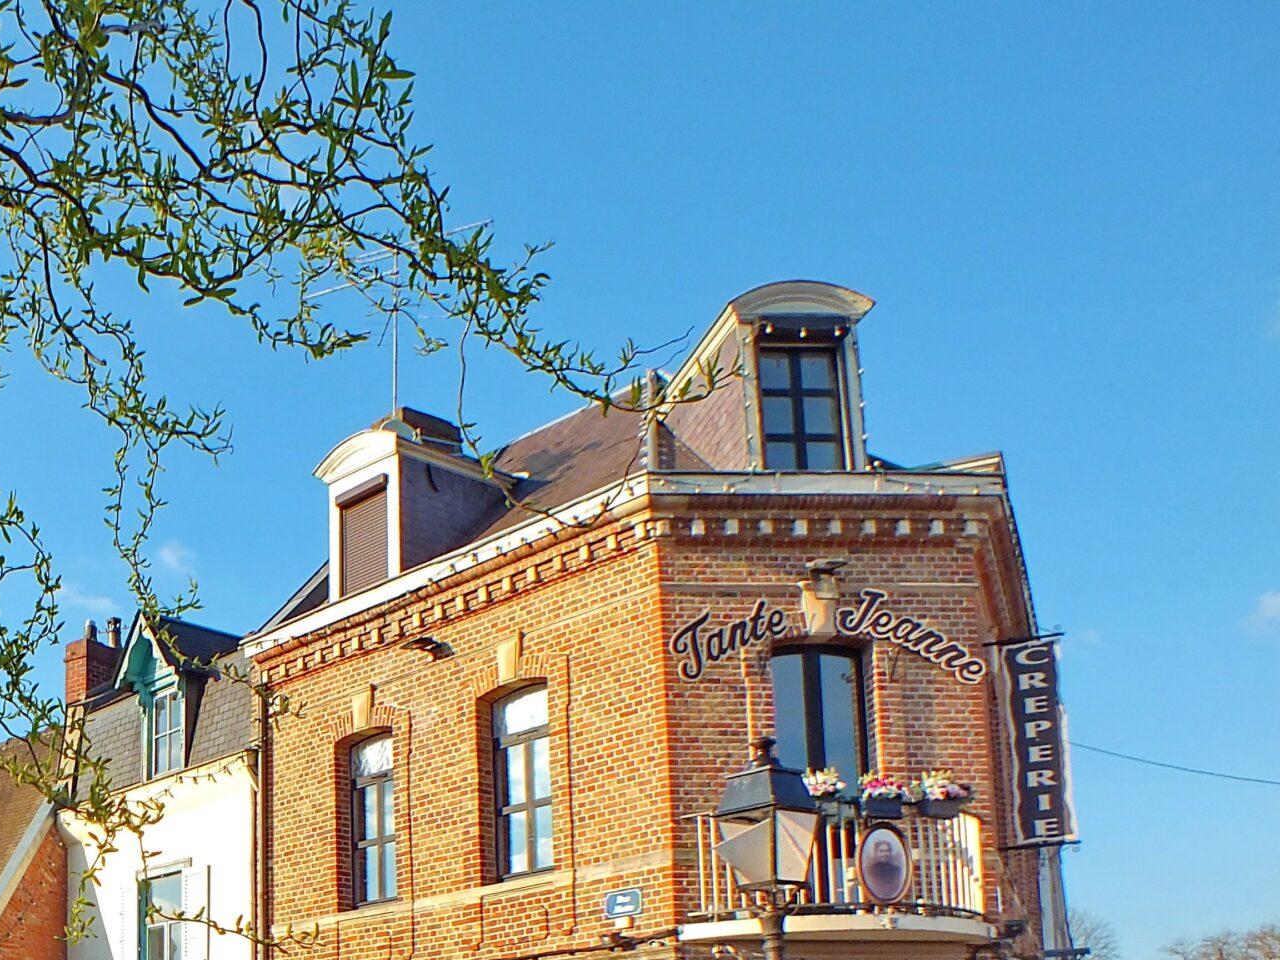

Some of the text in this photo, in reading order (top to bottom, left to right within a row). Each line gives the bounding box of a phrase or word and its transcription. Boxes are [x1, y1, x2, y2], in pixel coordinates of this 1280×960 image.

[670, 588, 986, 684] Tante Jeanne
[1015, 646, 1059, 836] CREPERIE
